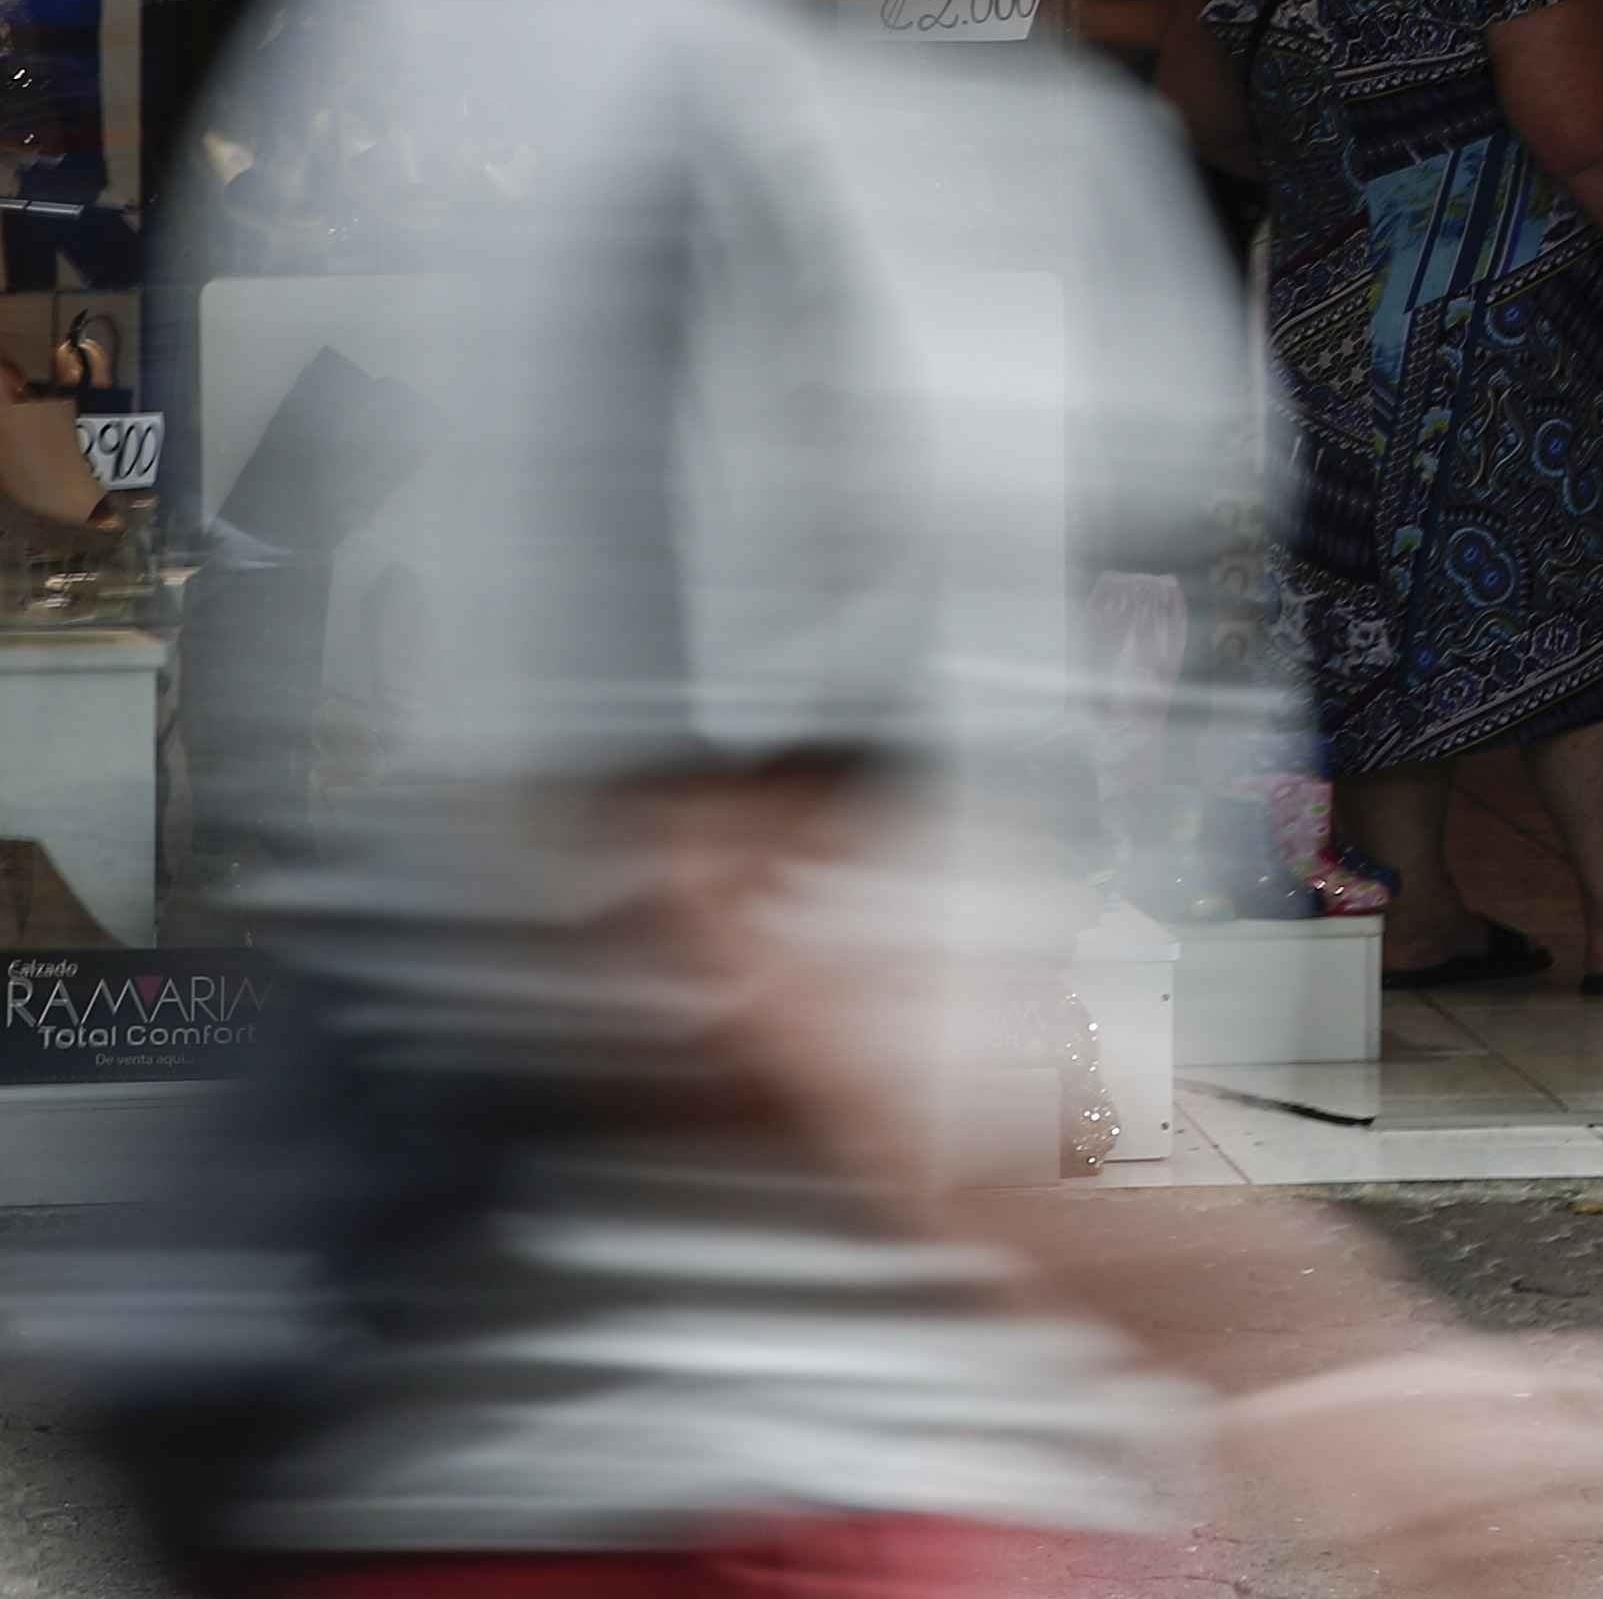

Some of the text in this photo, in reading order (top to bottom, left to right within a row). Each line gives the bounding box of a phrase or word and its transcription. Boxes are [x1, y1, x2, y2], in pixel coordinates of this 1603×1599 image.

[8, 958, 79, 979] Calzado
[37, 1024, 257, 1050] Total Comfort
[116, 1054, 153, 1066] venta
